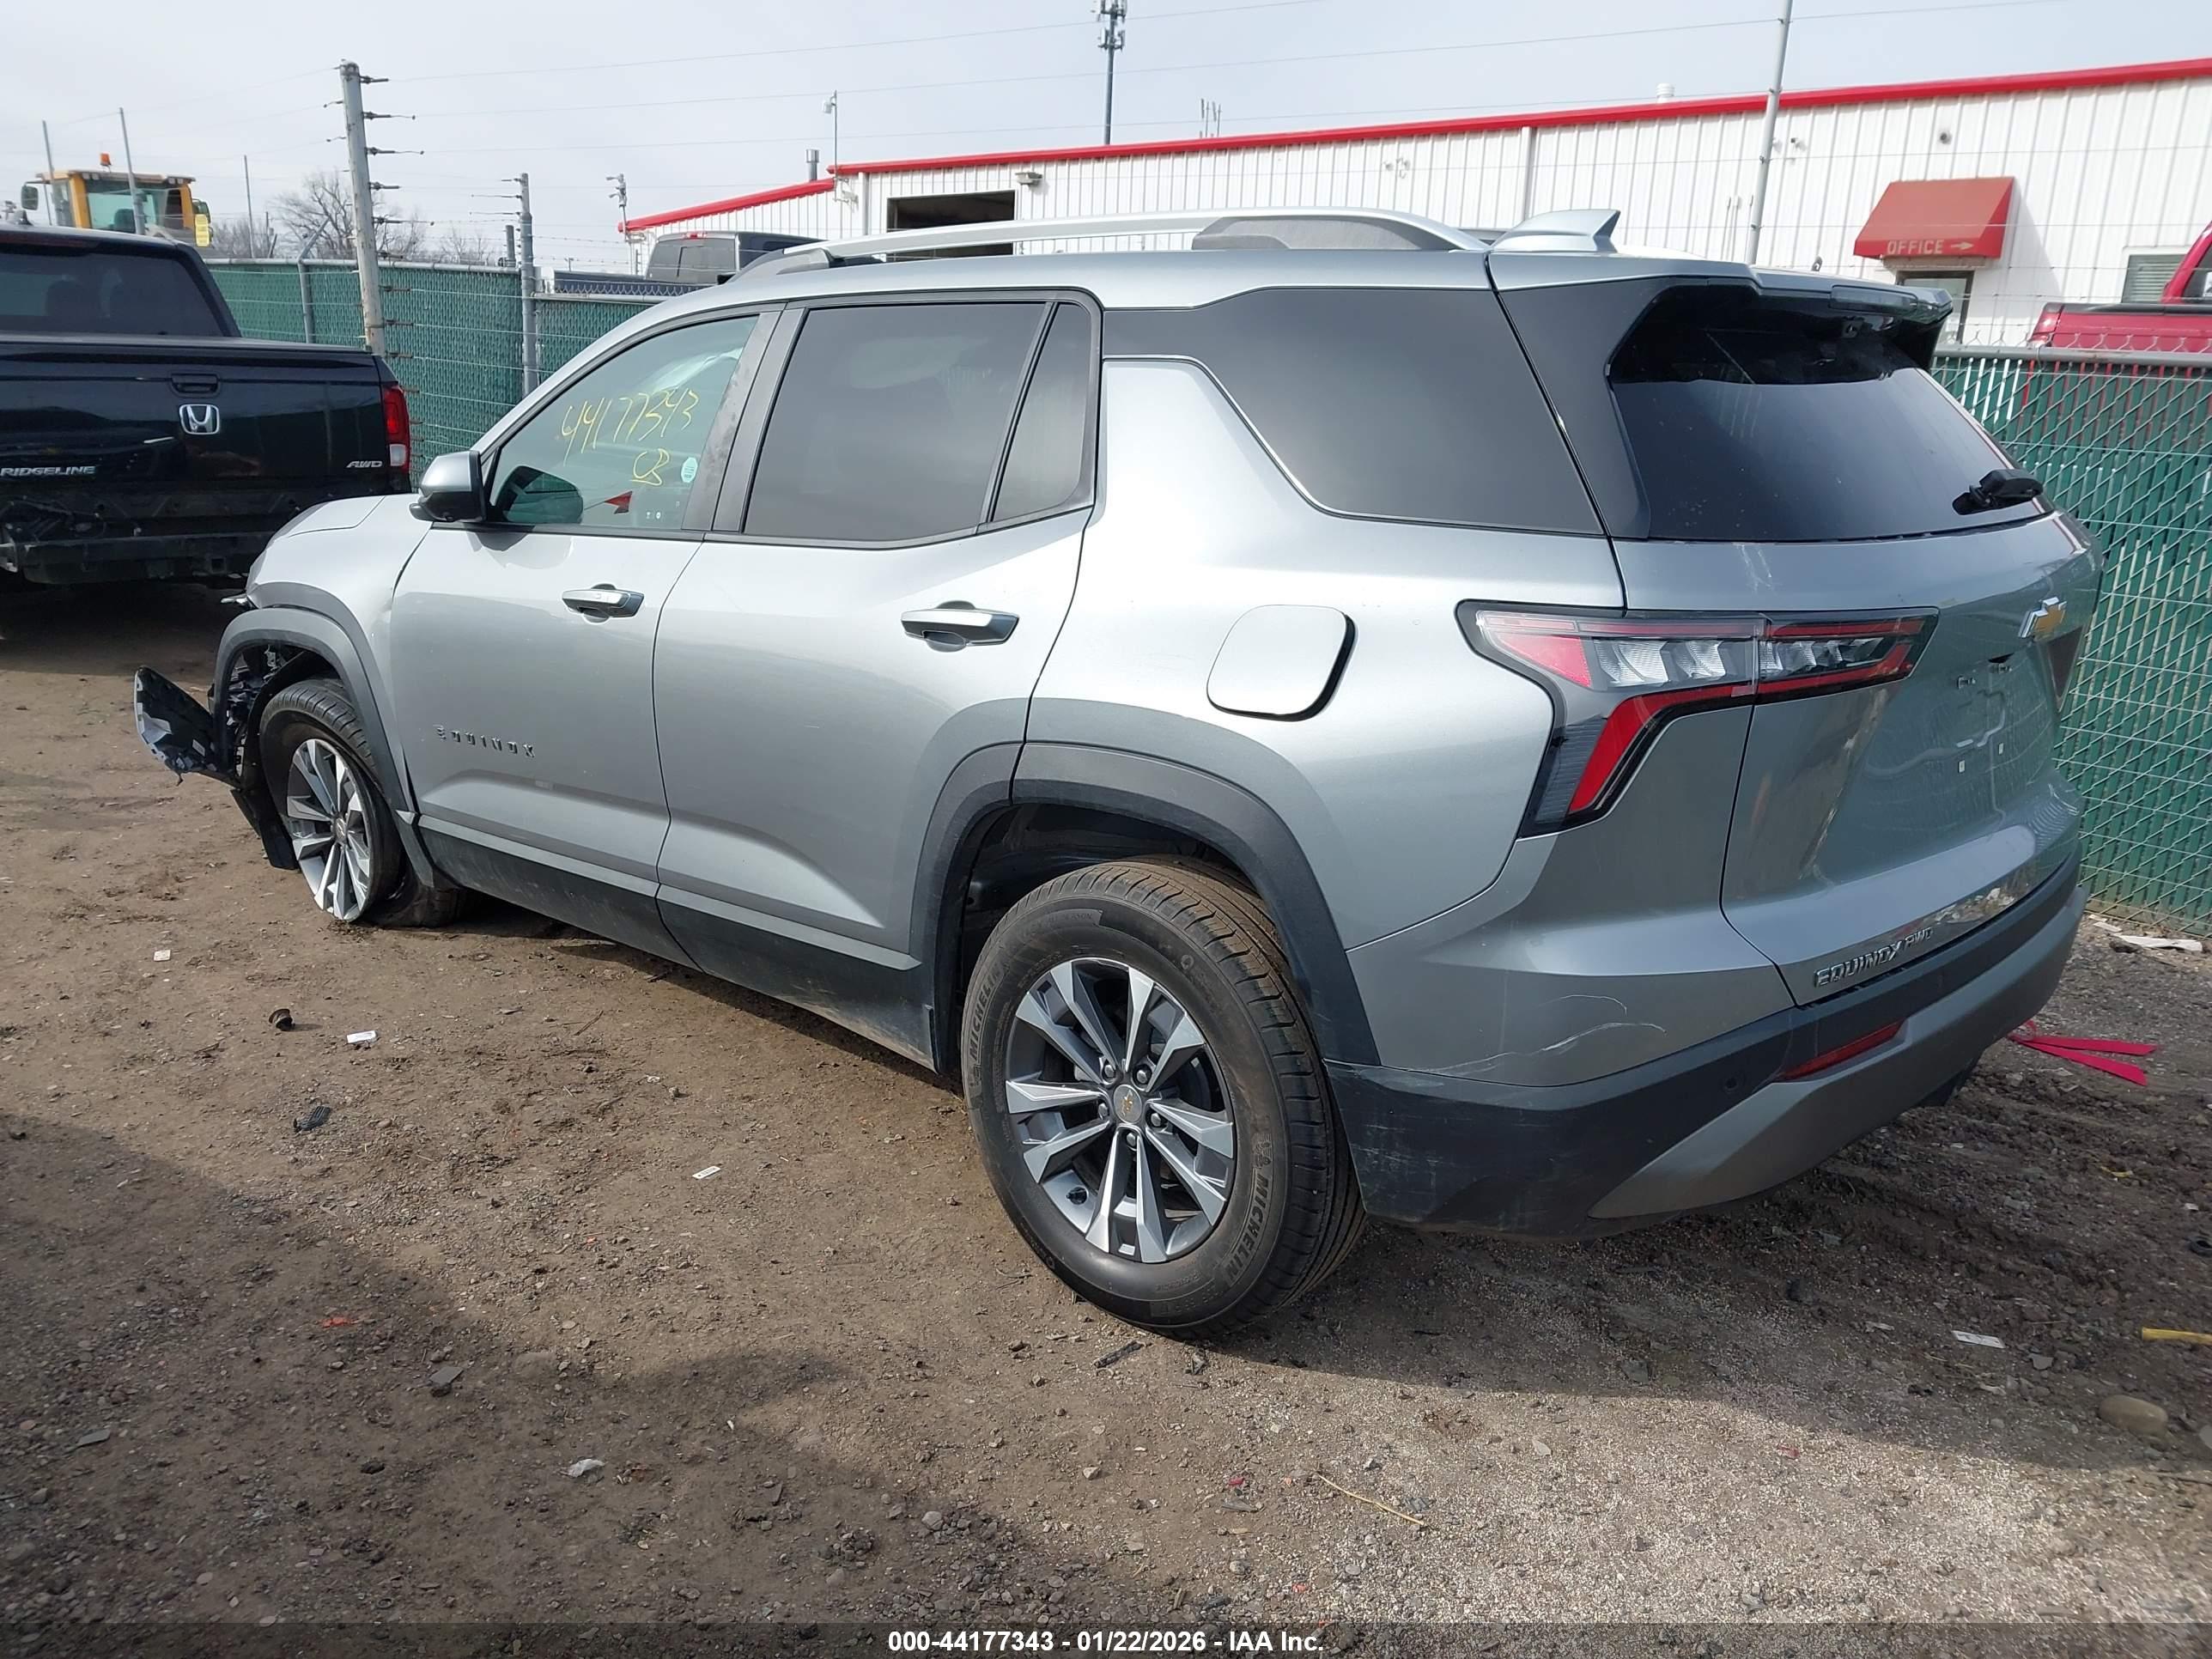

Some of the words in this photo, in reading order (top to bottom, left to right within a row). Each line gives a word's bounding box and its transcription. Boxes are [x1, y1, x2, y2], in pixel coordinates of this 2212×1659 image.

[1887, 240, 1944, 255] OFFICE
[561, 387, 700, 466] 44177343
[0, 465, 96, 477] RIDGELINE
[1815, 940, 1903, 987] EQUINOX
[1225, 1172, 1270, 1279] MICHELIN
